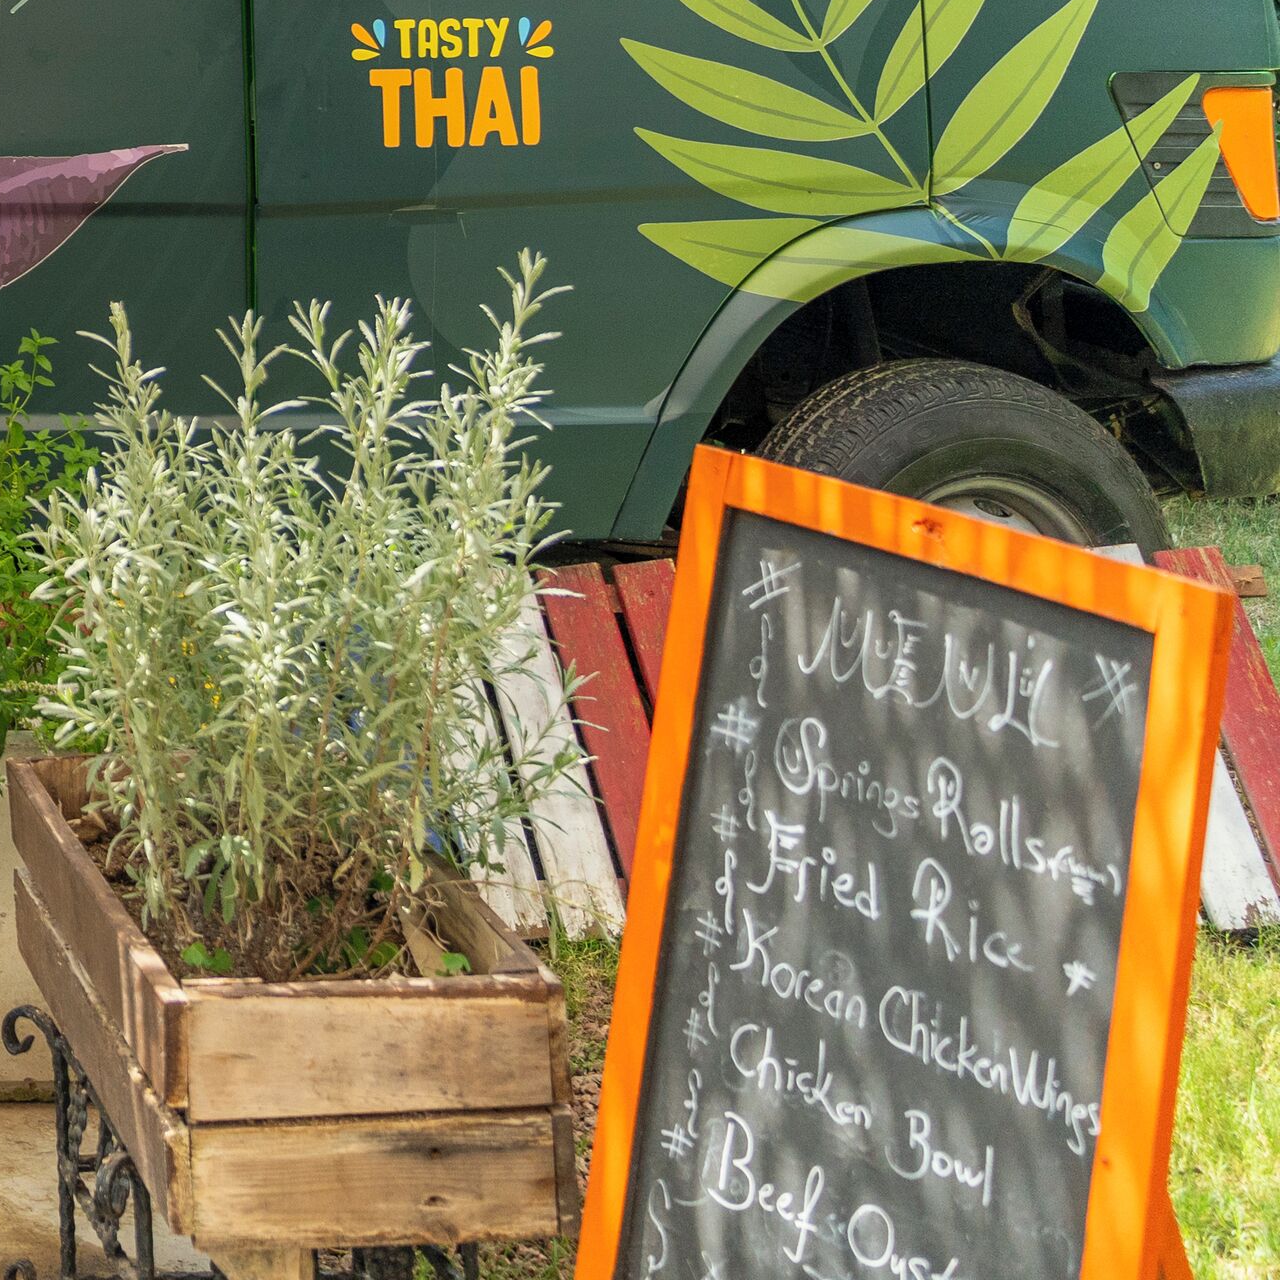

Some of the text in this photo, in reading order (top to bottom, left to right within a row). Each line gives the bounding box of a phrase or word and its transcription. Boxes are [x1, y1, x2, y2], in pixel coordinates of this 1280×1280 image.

[393, 17, 510, 59] TASTY
[369, 65, 541, 148] THAI
[927, 756, 1045, 874] Rolls
[745, 808, 880, 921] Fried
[909, 857, 1036, 973] Rice
[729, 907, 868, 1030] Korean
[729, 1022, 994, 1207] Chicken Bowl
[707, 1111, 827, 1263] Beef
